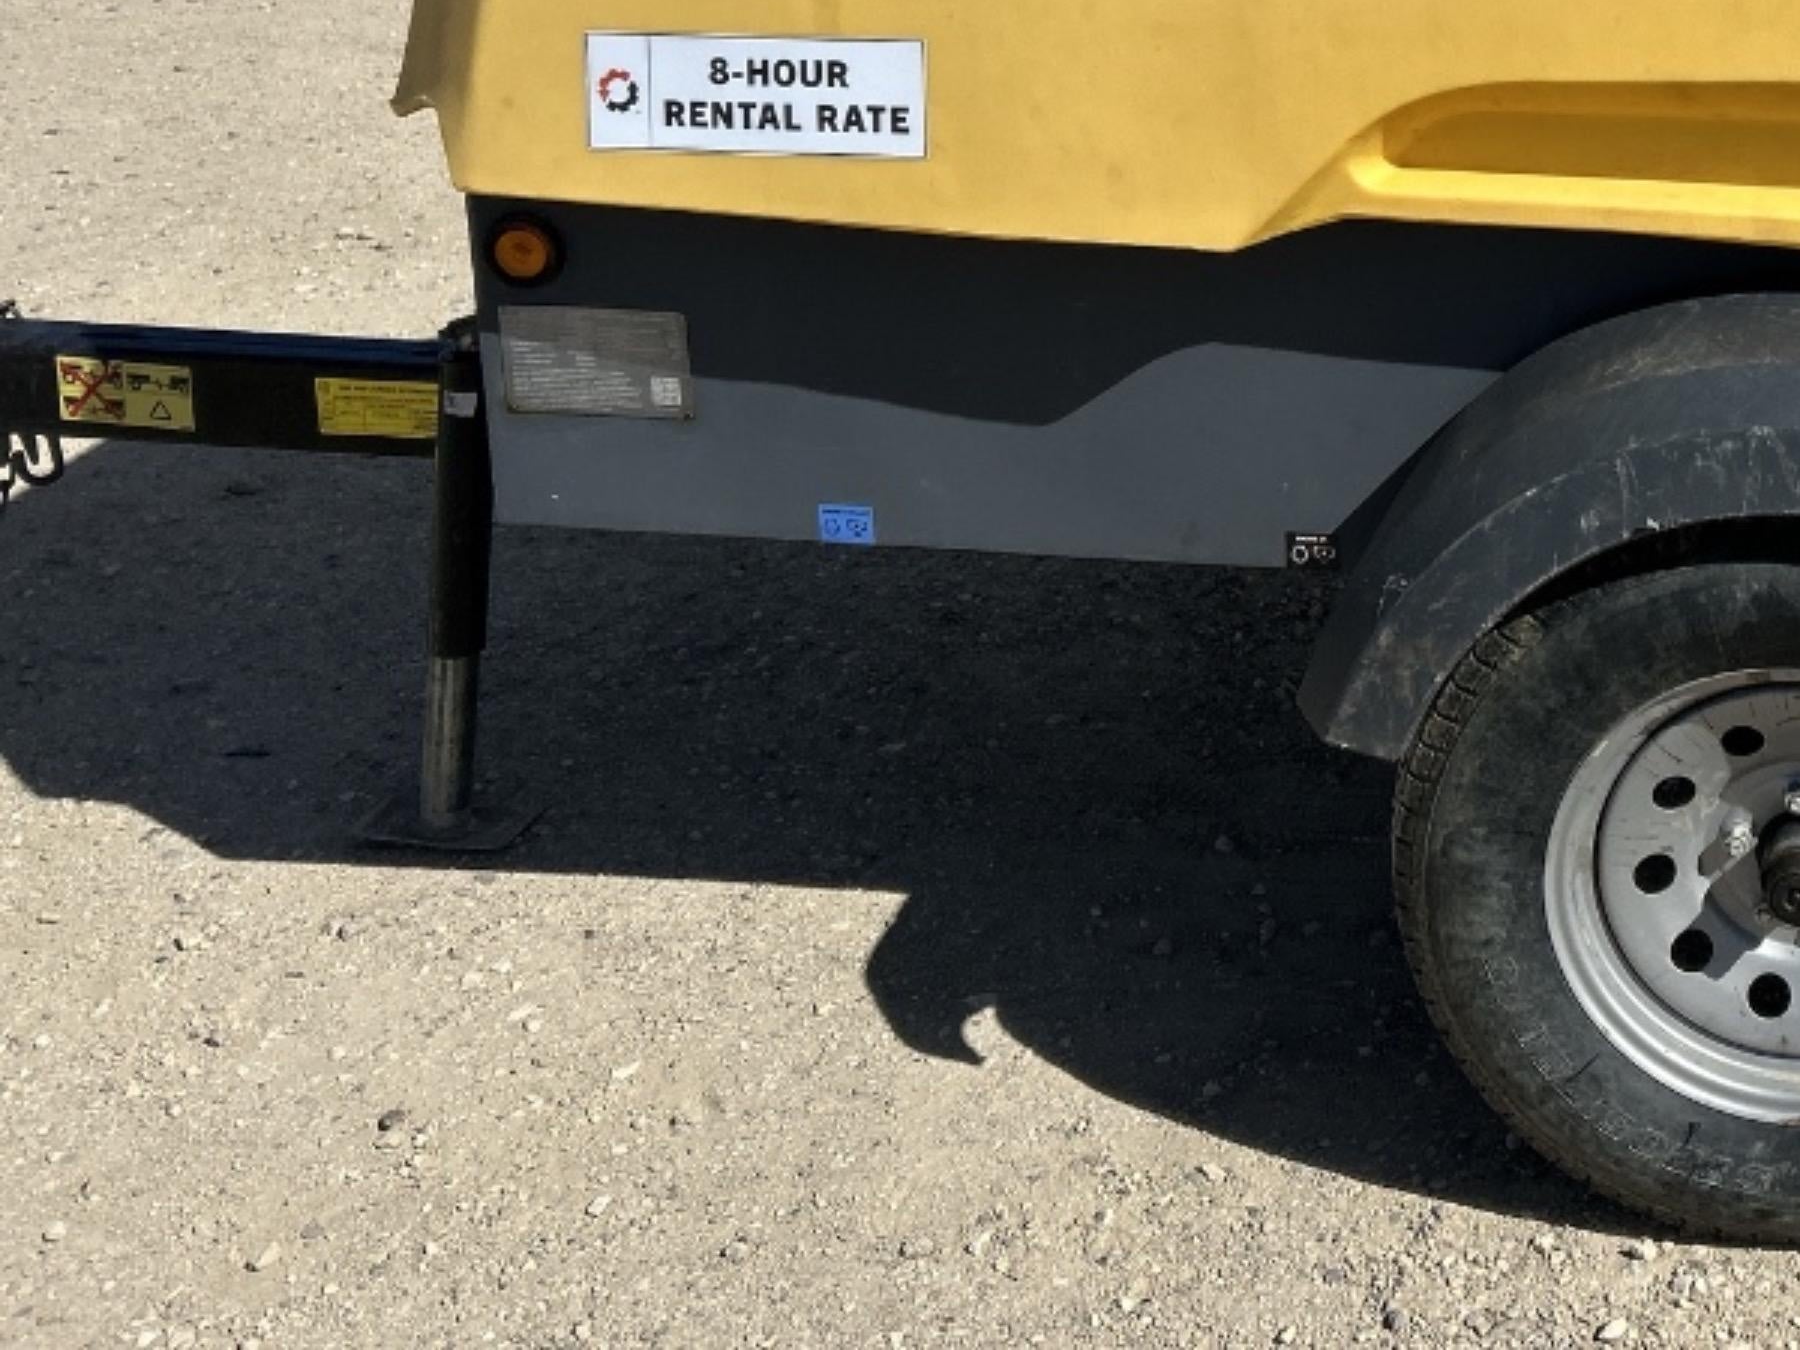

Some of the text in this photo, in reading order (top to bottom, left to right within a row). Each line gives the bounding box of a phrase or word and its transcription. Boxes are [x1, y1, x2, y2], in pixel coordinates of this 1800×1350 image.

[708, 57, 850, 88] 8-HOUR
[664, 100, 911, 134] RENTAL RATE
